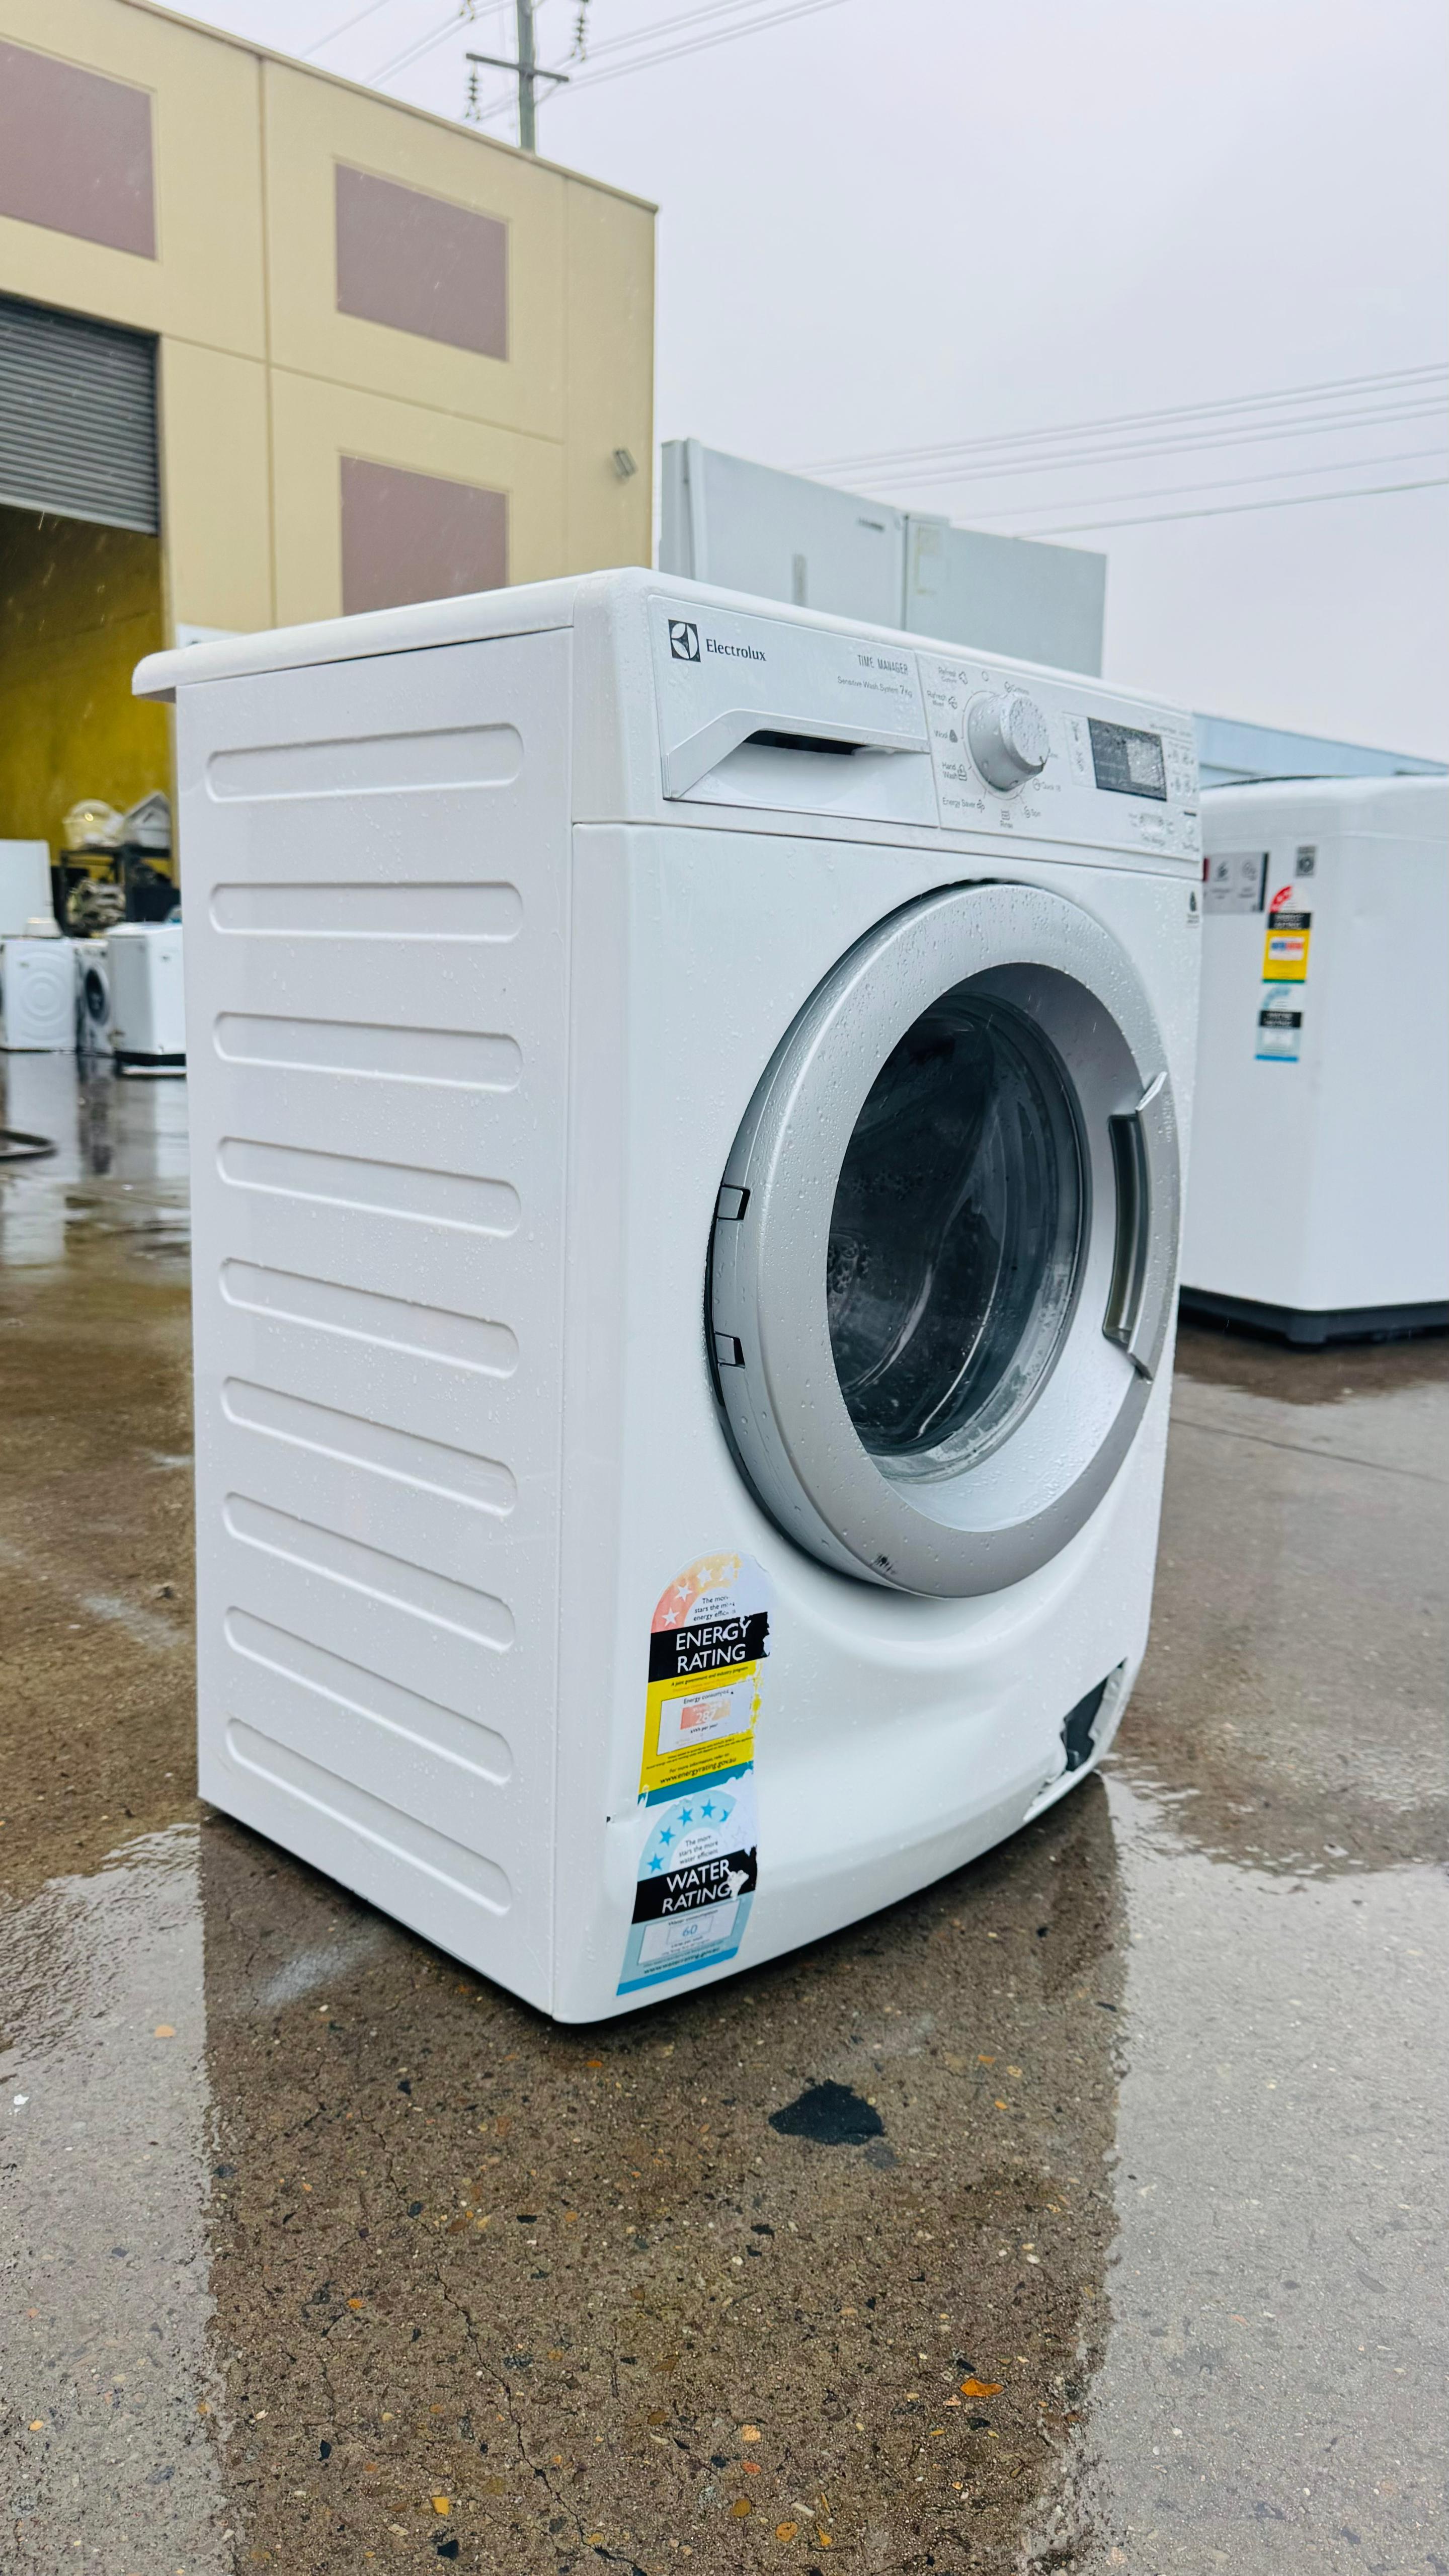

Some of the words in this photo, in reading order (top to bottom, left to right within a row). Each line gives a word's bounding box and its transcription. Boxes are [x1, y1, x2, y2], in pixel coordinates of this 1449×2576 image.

[706, 638, 767, 662] Electrolux
[857, 655, 874, 669] TIME
[877, 658, 909, 675] MANAGER
[942, 797, 960, 809] Energy
[676, 1620, 752, 1651] ENERGY
[677, 1643, 746, 1673] RATING
[667, 1859, 732, 1893] WATER
[662, 1881, 732, 1914] RATING
[683, 1924, 698, 1937] 60
